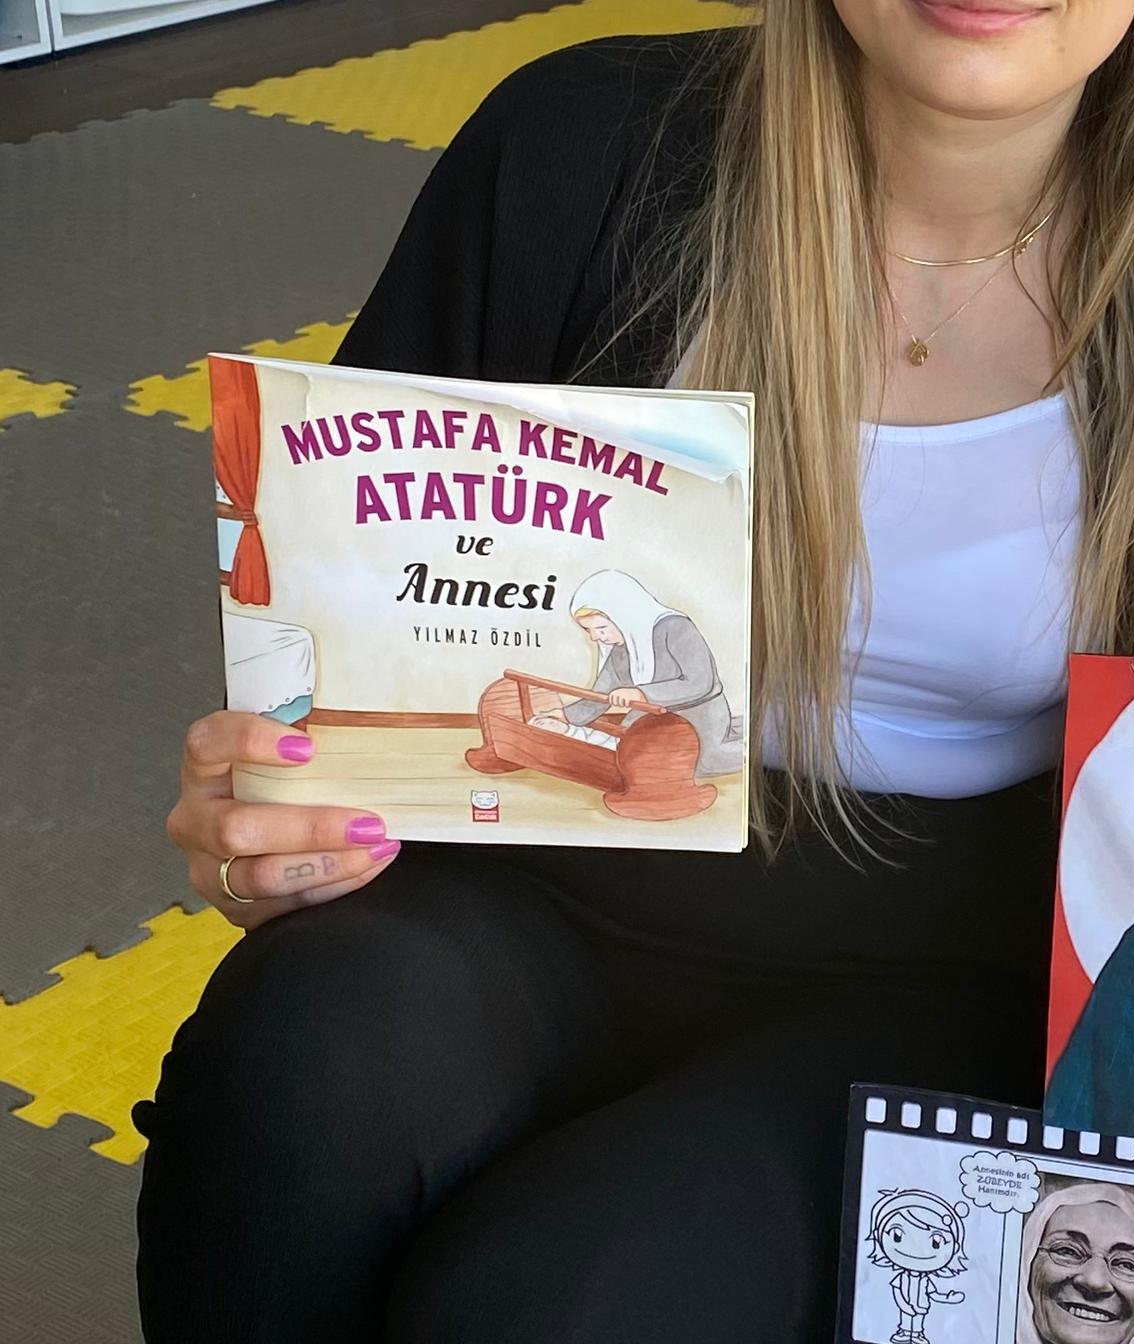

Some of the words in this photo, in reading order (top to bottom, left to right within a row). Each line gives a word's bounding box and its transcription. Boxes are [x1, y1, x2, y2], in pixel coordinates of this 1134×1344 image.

[281, 409, 502, 465] MUSTAFA
[518, 419, 669, 496] KEMAL
[355, 463, 613, 541] ATATÜRK
[455, 534, 494, 556] ve
[396, 562, 558, 611] Annesi
[413, 626, 478, 645] YILMAZ
[490, 627, 542, 648] ÖZDİL
